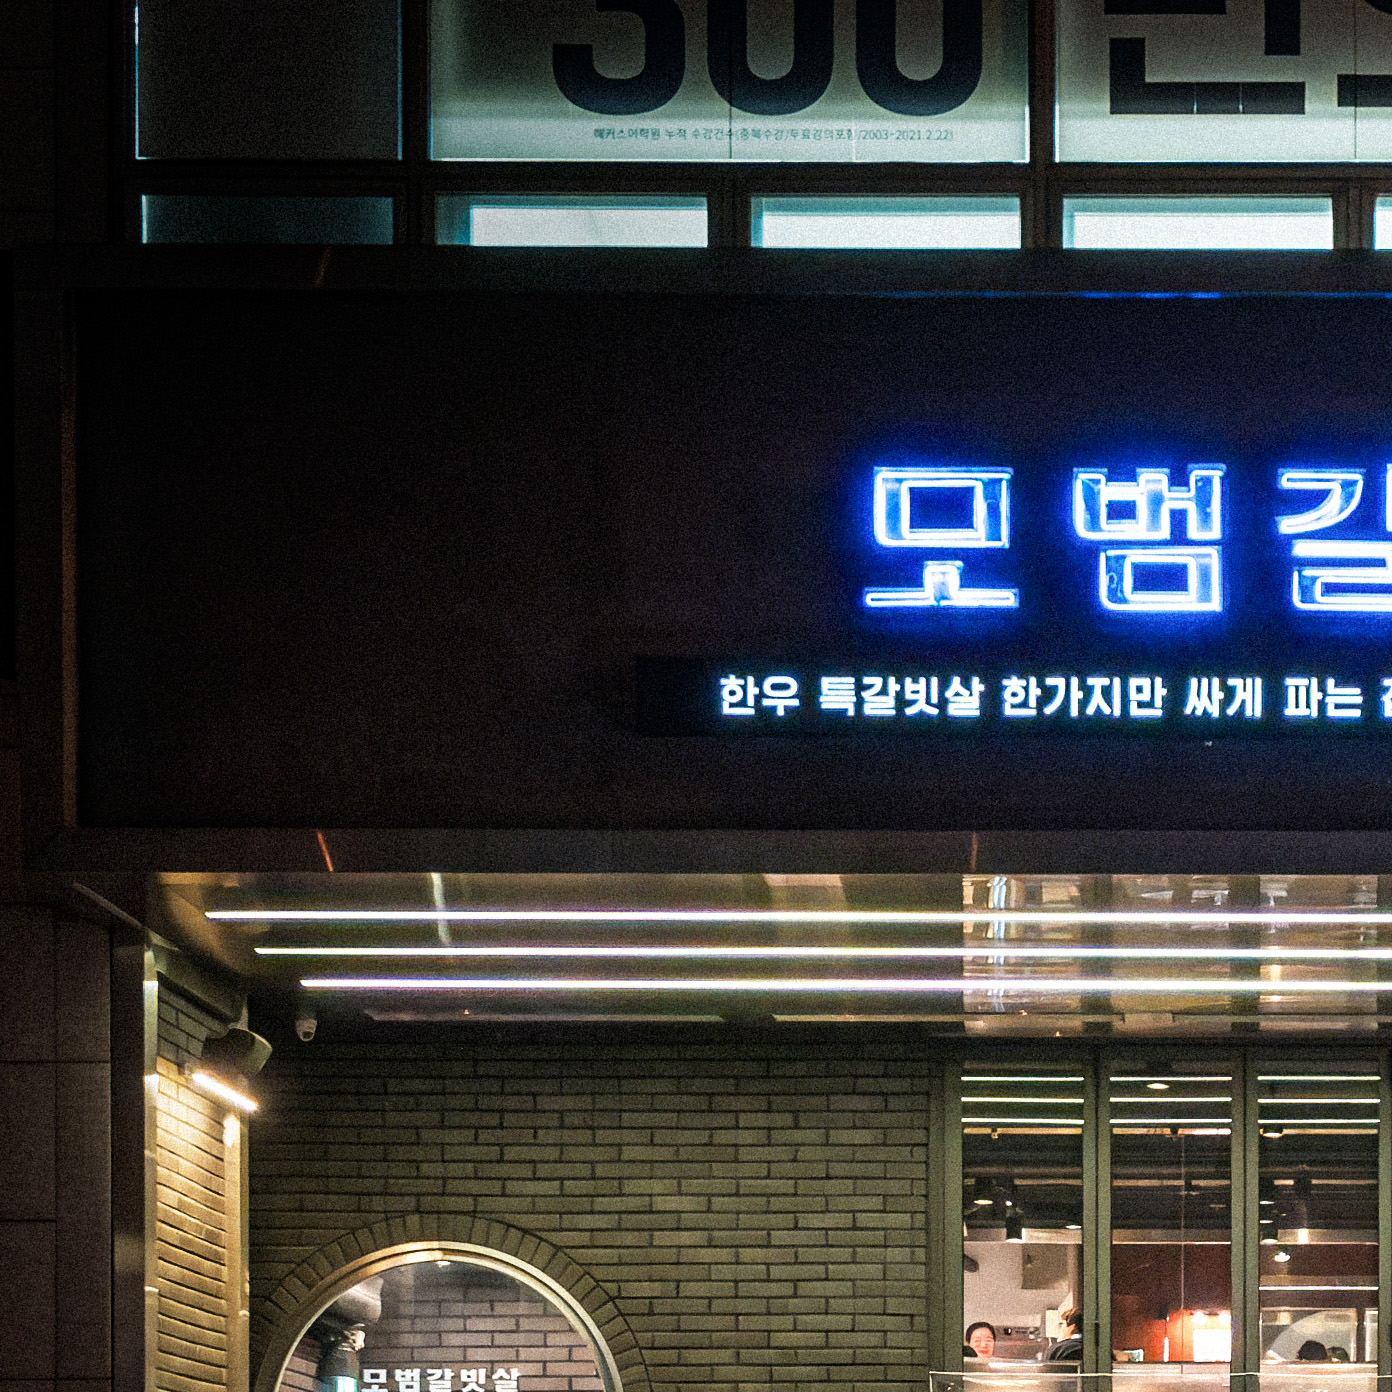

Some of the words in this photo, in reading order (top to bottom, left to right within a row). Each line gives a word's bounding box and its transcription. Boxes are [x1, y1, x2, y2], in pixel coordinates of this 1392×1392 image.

[720, 675, 799, 717] 한우
[819, 675, 985, 718] 특갈빗살
[1002, 675, 1167, 718] 한가지만
[1184, 676, 1262, 718] 싸게
[1284, 677, 1363, 718] 파는
